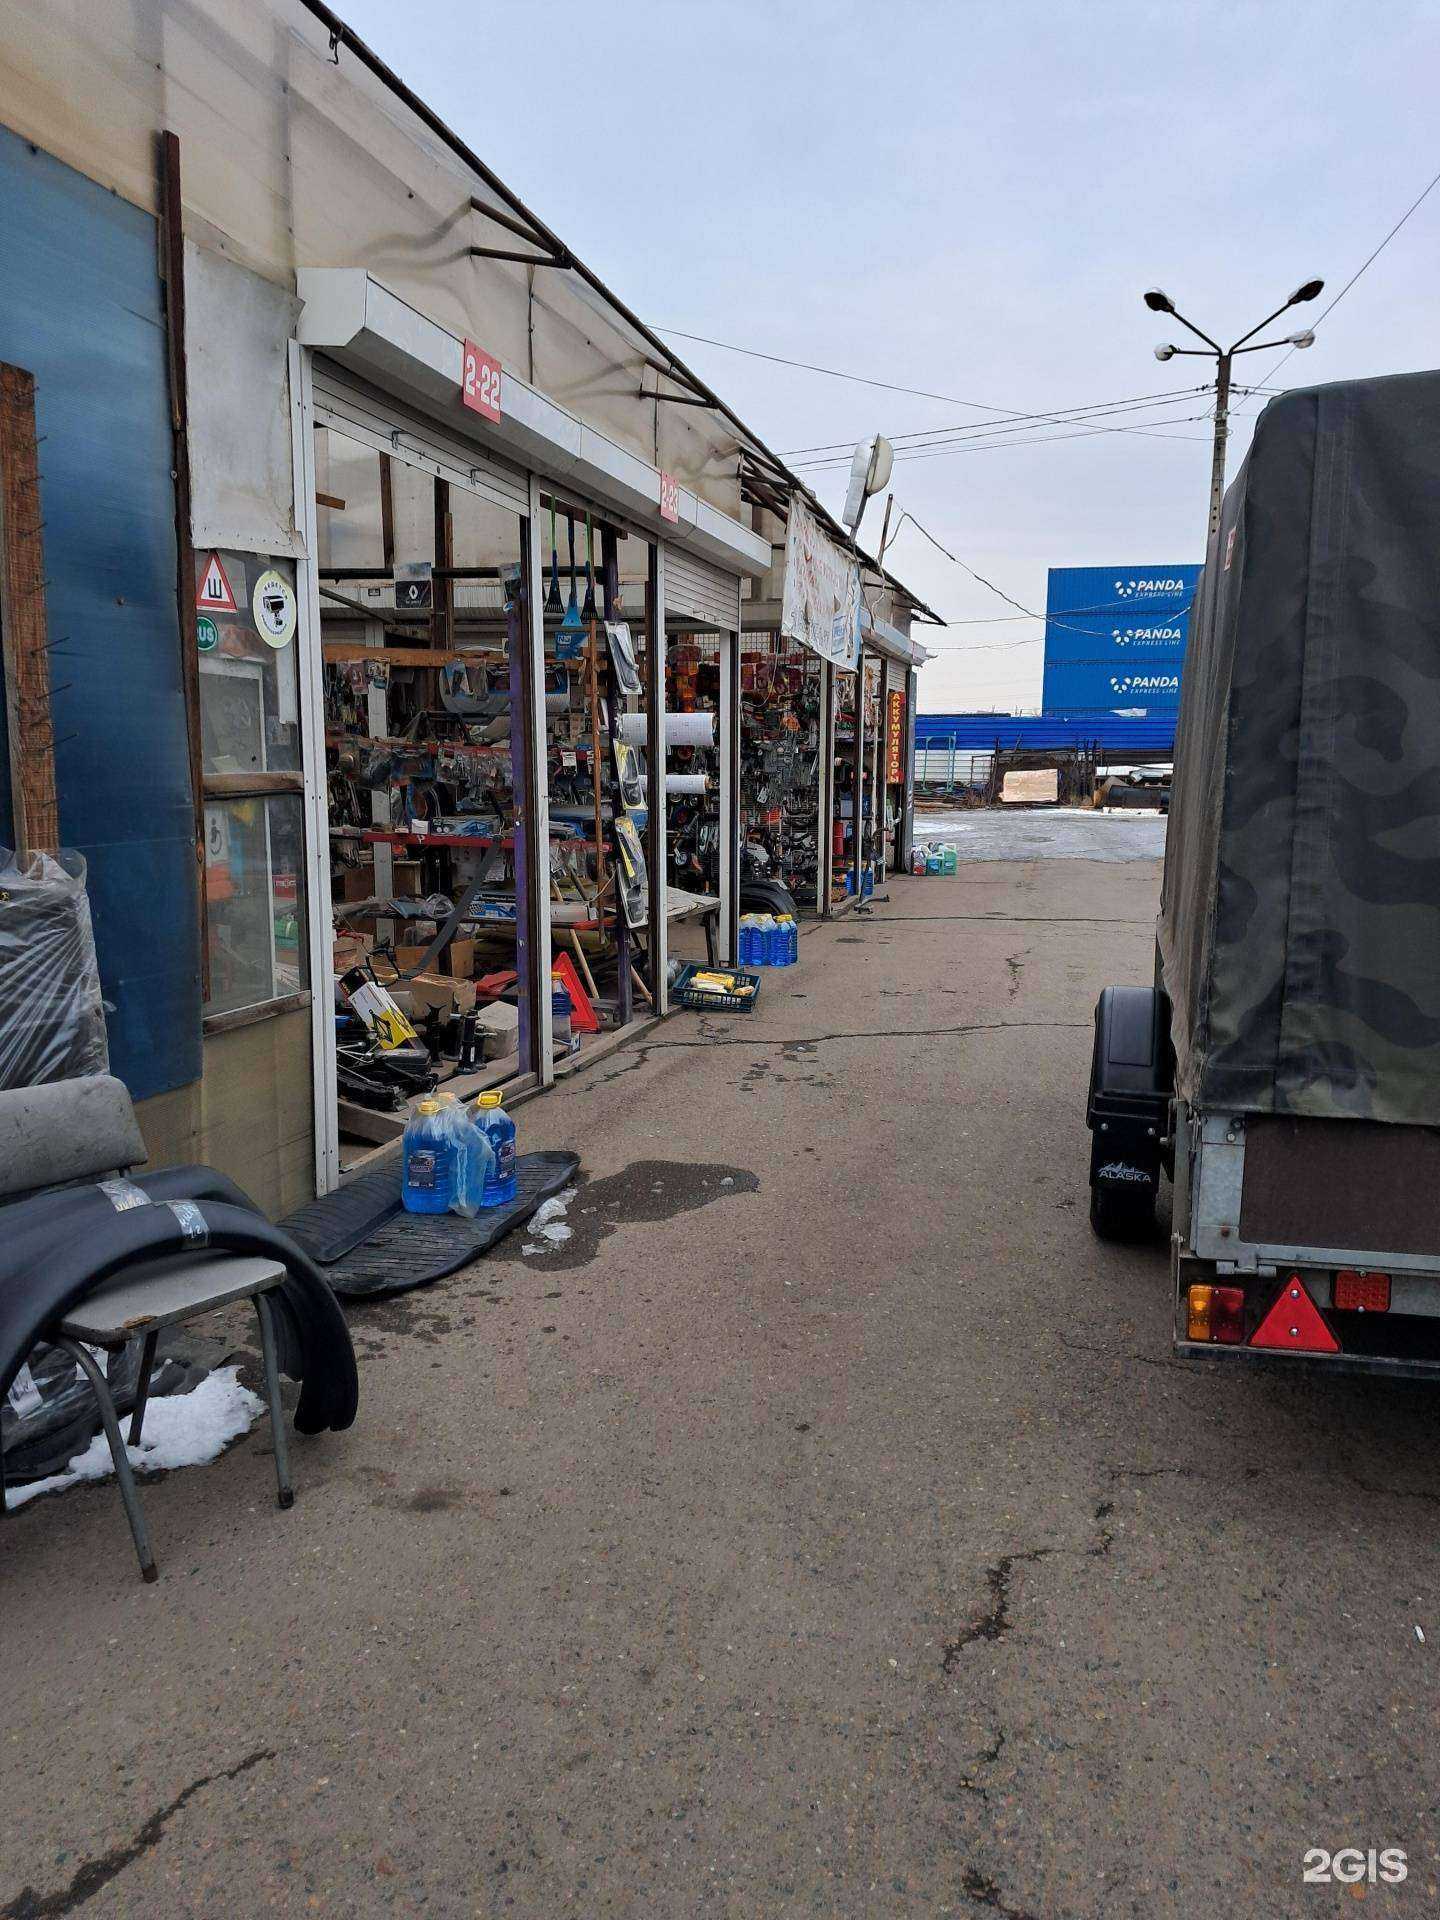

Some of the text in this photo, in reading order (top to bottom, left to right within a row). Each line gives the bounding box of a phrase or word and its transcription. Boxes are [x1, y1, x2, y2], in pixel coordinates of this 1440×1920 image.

[465, 354, 500, 411] 2-22
[208, 578, 222, 599] Ш
[1137, 579, 1184, 591] PANDA
[1134, 628, 1181, 639] PANDA
[1132, 676, 1179, 687] PANDA
[891, 693, 900, 783] АККУМУЛЯТОРЫ
[1098, 1171, 1152, 1182] ALASKA
